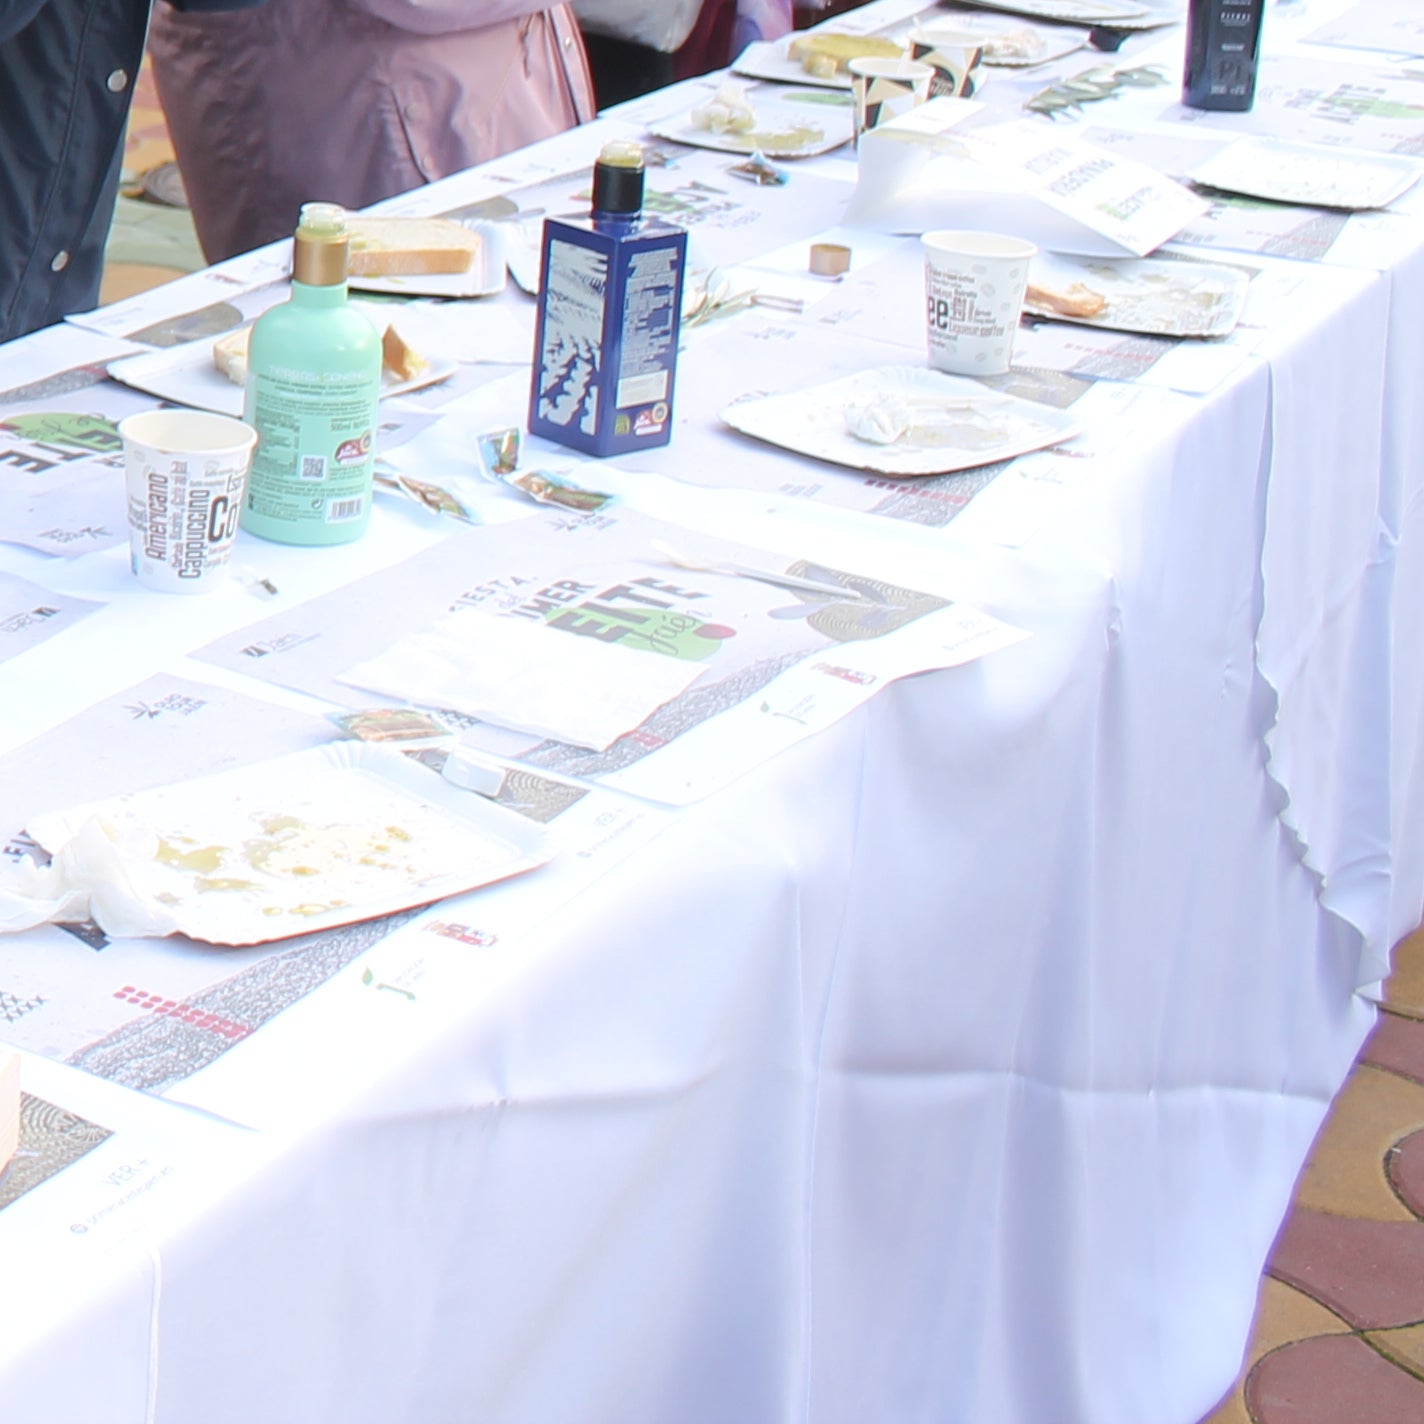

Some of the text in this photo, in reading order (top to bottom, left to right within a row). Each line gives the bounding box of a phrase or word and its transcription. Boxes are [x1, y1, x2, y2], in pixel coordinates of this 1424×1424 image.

[145, 472, 168, 561] Americano
[178, 489, 210, 579] Cappuccino
[449, 575, 534, 613] IESTA
[497, 579, 597, 620] IMER
[545, 576, 712, 643] EITE
